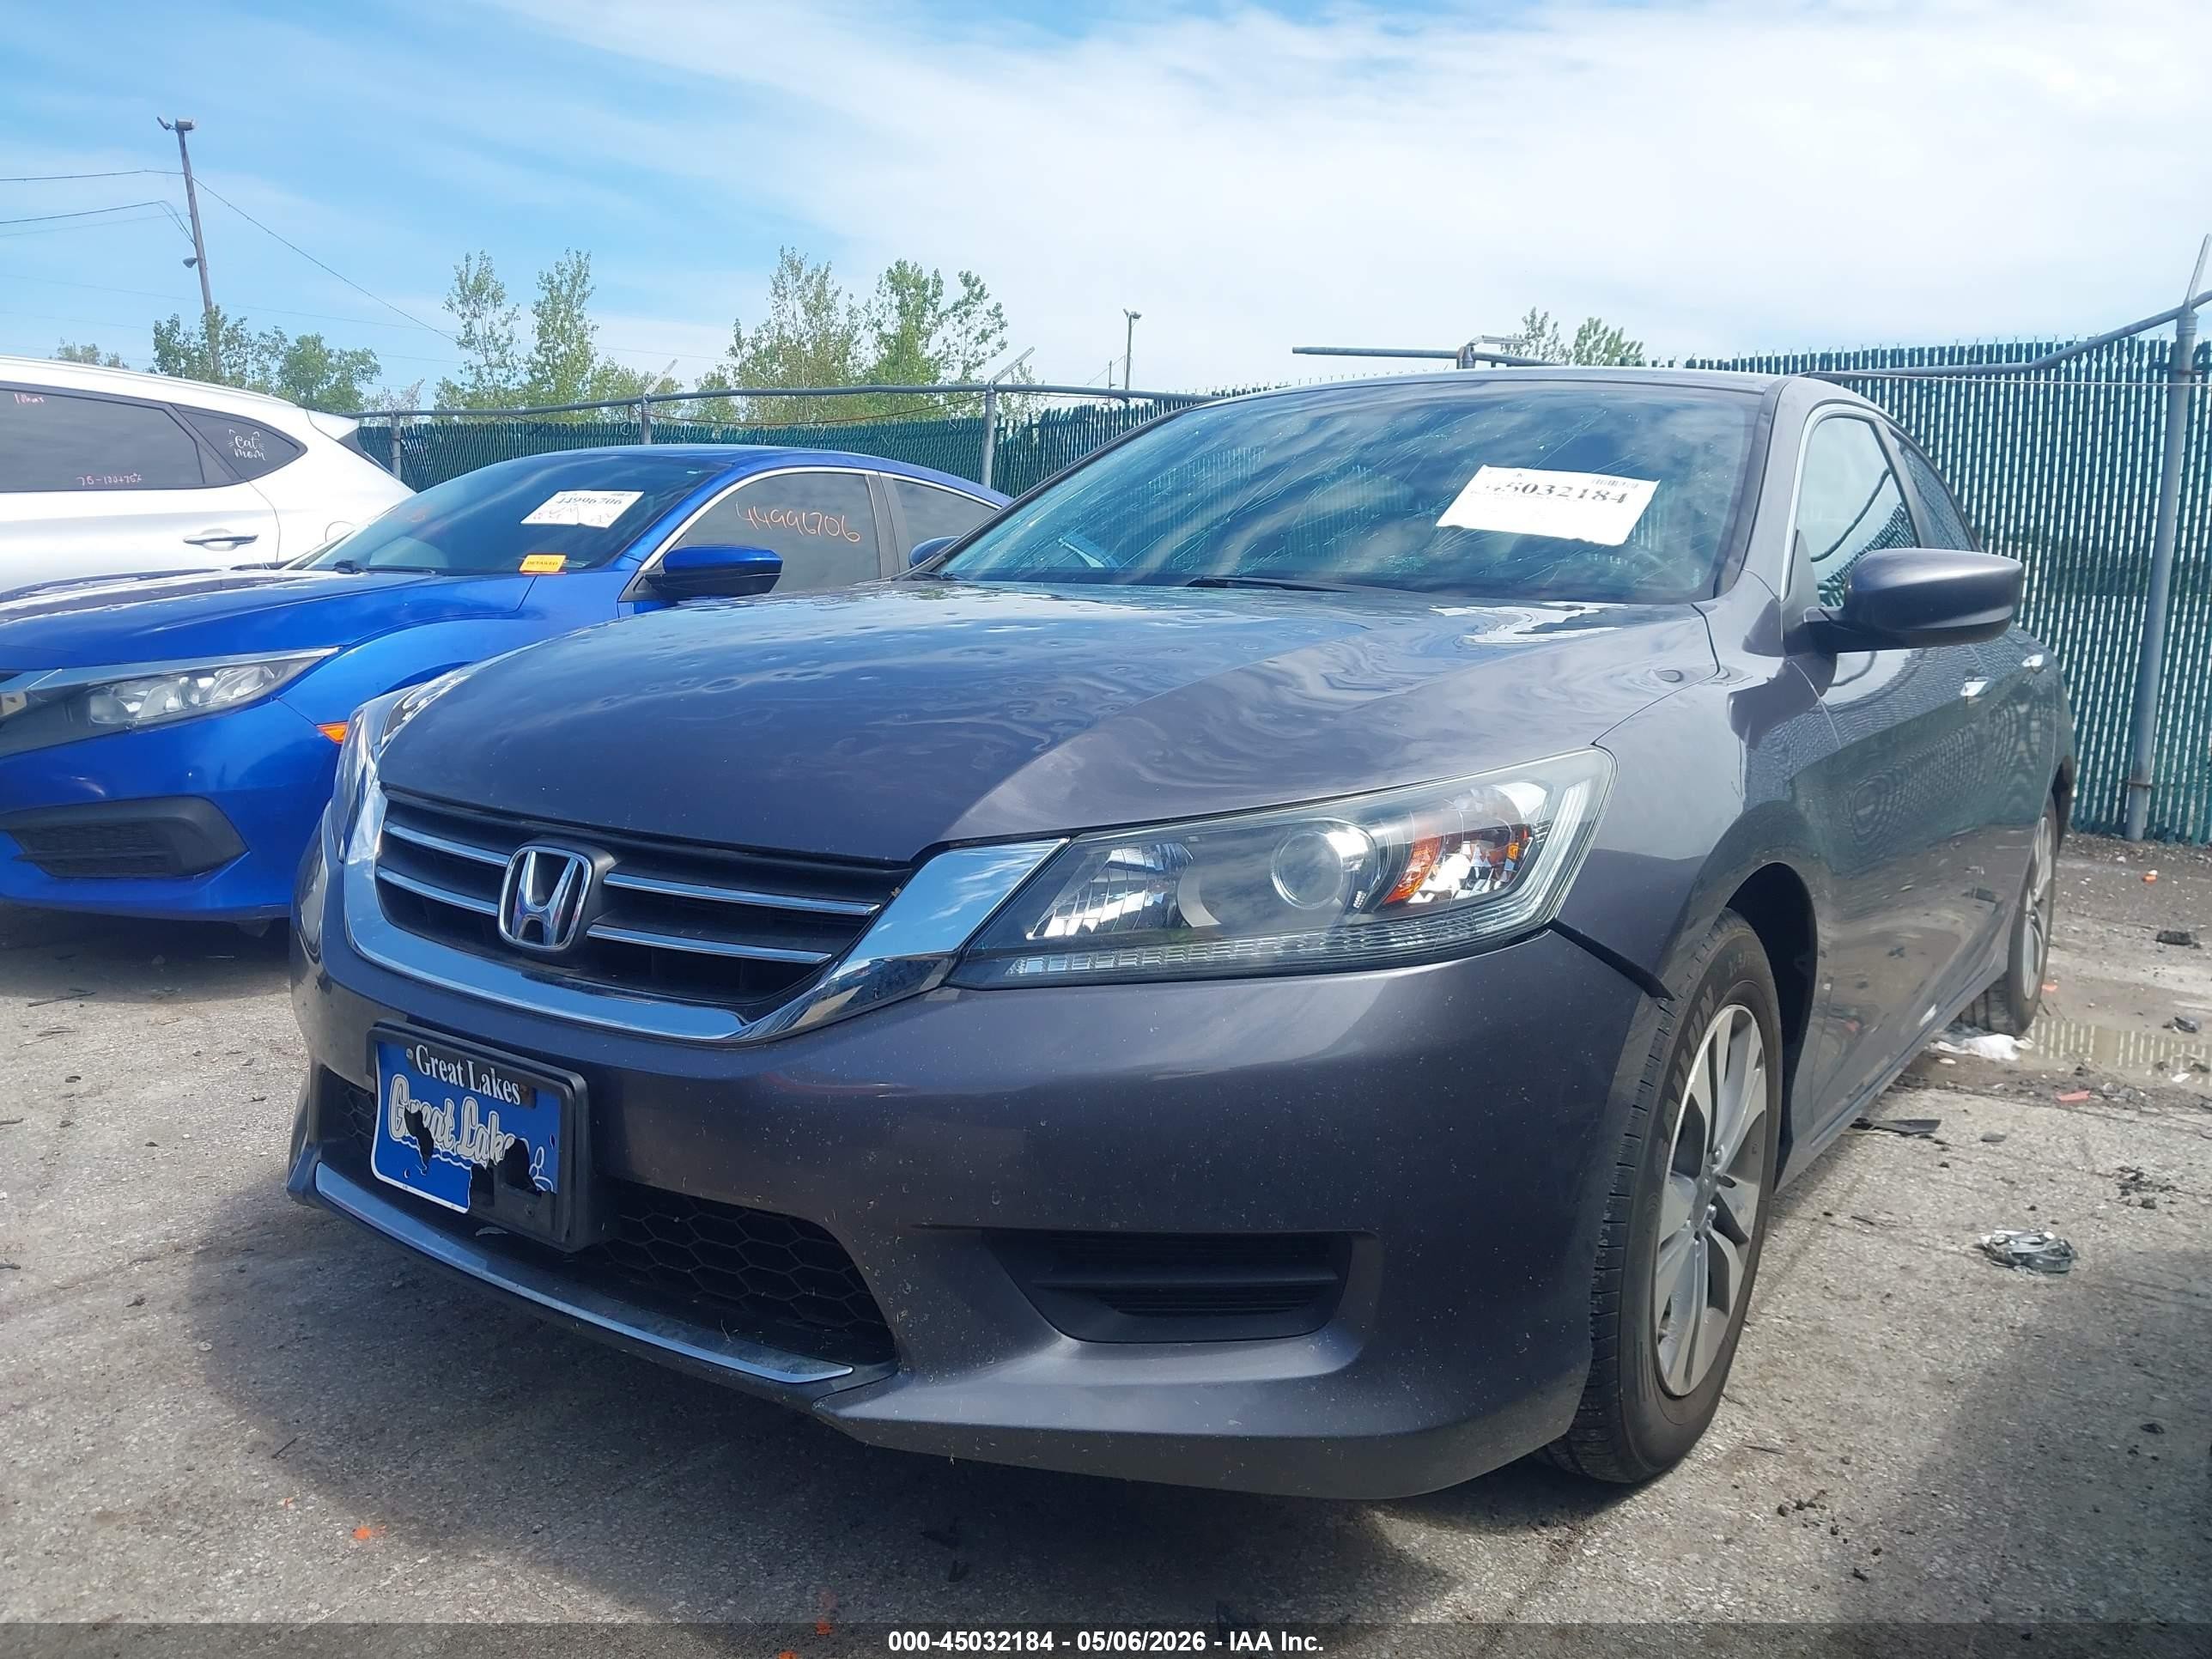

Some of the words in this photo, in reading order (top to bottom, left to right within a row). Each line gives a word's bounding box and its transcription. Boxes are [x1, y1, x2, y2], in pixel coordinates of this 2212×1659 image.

[234, 435, 260, 450] Cat
[735, 501, 860, 543] 44996706
[416, 1044, 465, 1088] Great
[468, 1060, 521, 1106] Lakes
